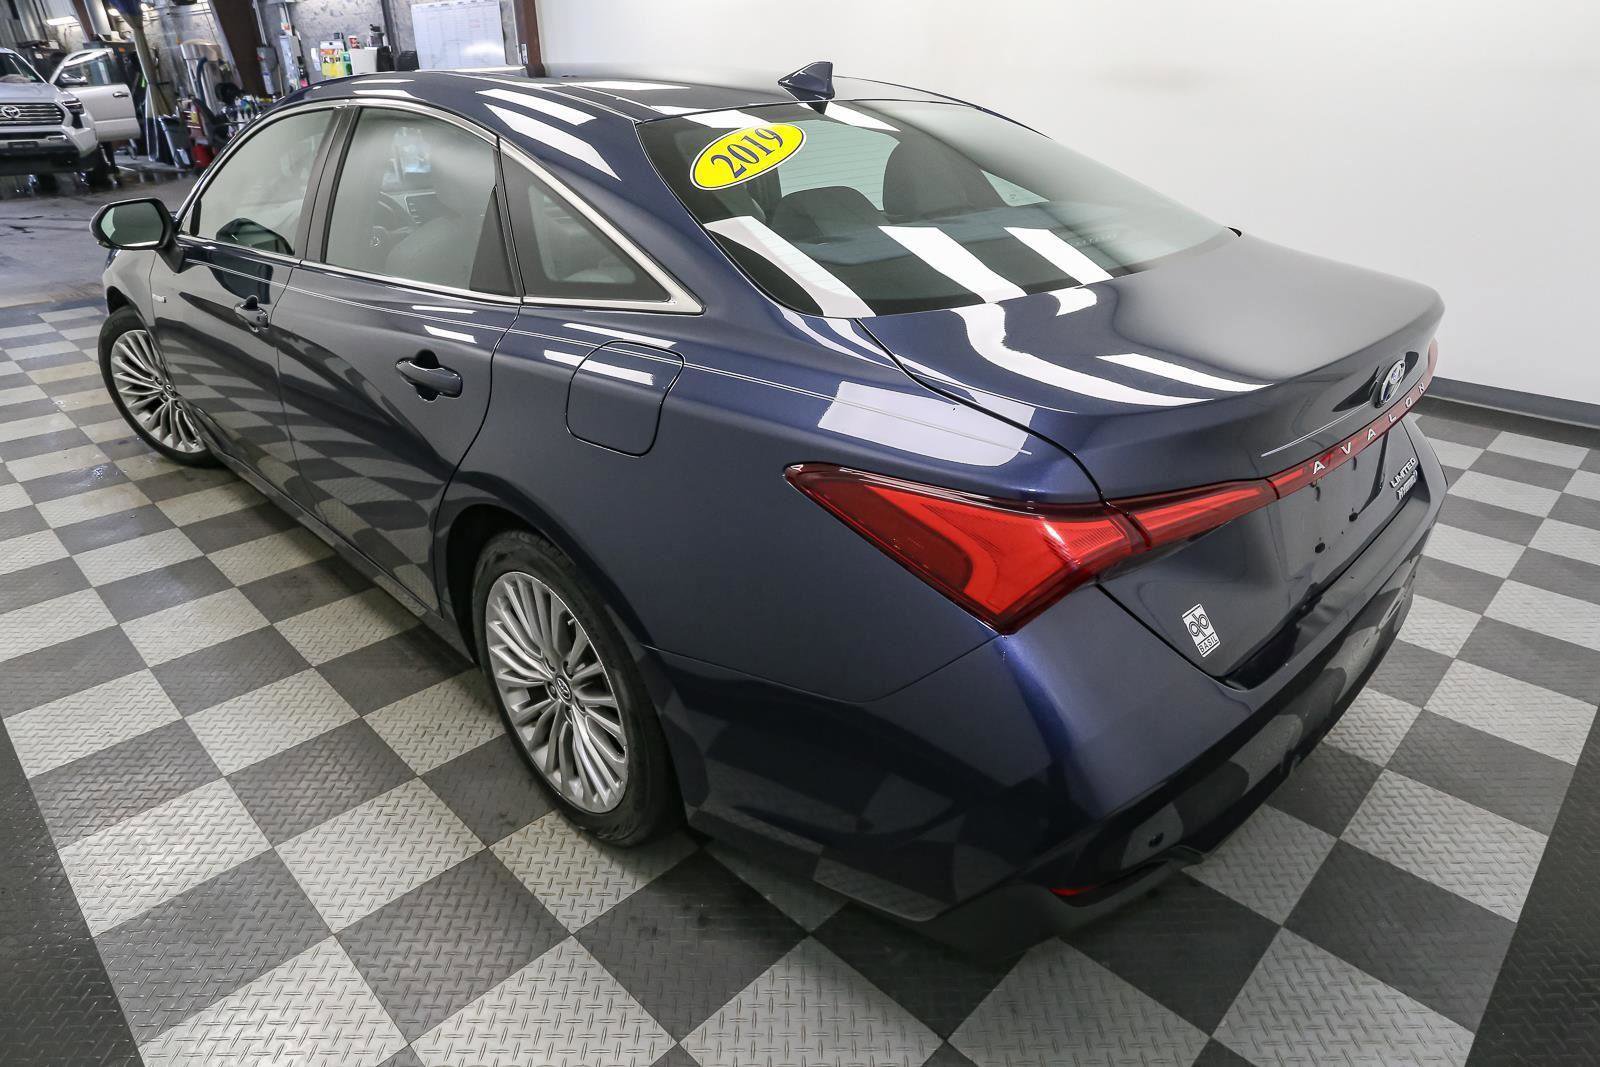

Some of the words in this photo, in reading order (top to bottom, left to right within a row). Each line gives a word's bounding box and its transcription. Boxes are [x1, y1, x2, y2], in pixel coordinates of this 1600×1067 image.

[710, 128, 784, 178] 2019
[1312, 382, 1425, 475] AVALON
[1389, 457, 1417, 488] LIMITED
[1198, 635, 1218, 653] BASIL
